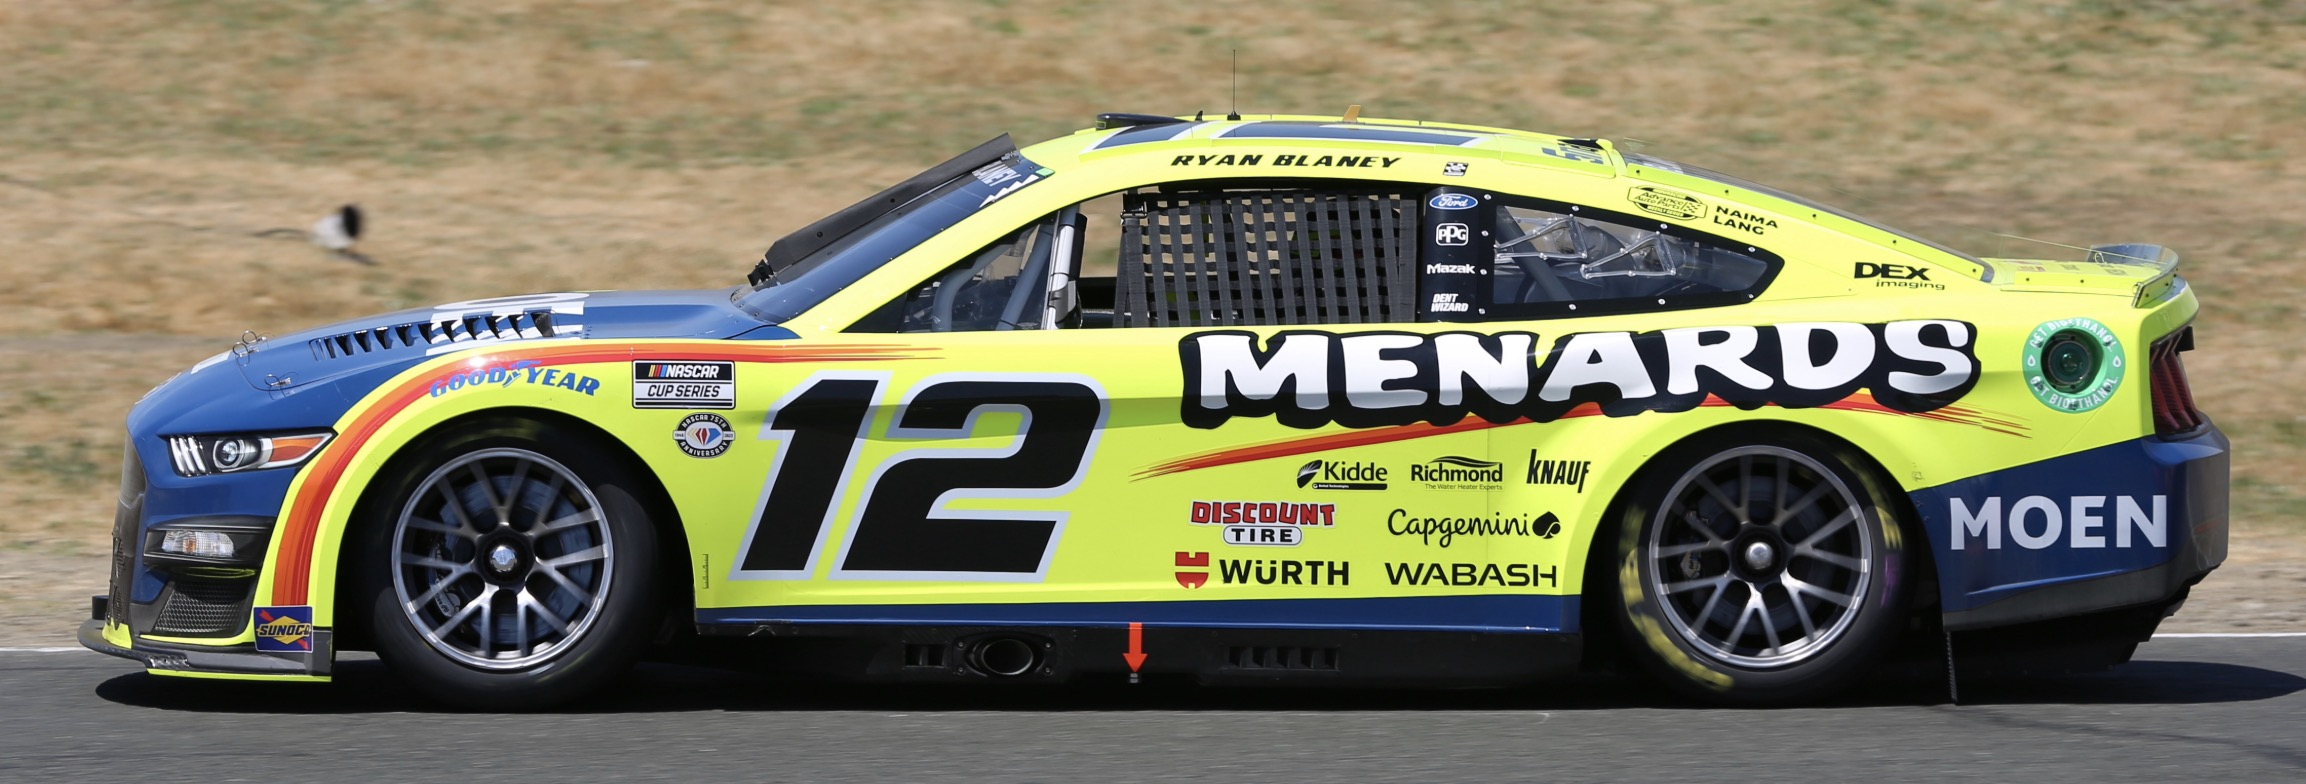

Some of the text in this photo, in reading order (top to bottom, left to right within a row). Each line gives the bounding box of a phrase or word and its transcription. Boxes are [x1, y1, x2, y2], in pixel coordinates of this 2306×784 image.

[1170, 154, 1402, 168] RYAN BLANEY
[1438, 194, 1468, 207] Ford
[1714, 215, 1765, 235] LANG
[1716, 206, 1778, 229] NAIMA
[1438, 225, 1466, 243] PPG
[1426, 262, 1475, 275] Mazak
[1854, 262, 1931, 281] DEX
[1876, 279, 1945, 291] imaging
[1431, 302, 1469, 312] WIZARD
[1432, 293, 1458, 303] DENT
[2029, 318, 2118, 353] GET BIOETHANOL
[663, 364, 720, 379] NASCAR
[1190, 318, 1973, 416] MENARDS
[647, 384, 721, 398] CUP SERIES
[2048, 376, 2119, 410] BIOETHANOL
[681, 414, 727, 428] NASCAR 75TH
[680, 441, 728, 457] ANNIVERSARY
[733, 373, 1108, 579] 12
[1325, 461, 1388, 481] Kidde
[1411, 462, 1503, 482] Richmond
[1526, 448, 1591, 494] KNAUF
[1191, 501, 1335, 526] DISCOUNT
[1950, 495, 2167, 550] MOEN
[1231, 528, 1293, 543] TIRE
[1387, 508, 1530, 548] Capgemini
[1219, 559, 1349, 586] WÜRTH
[1384, 562, 1557, 588] WABASH
[258, 623, 312, 638] SUNOCO
